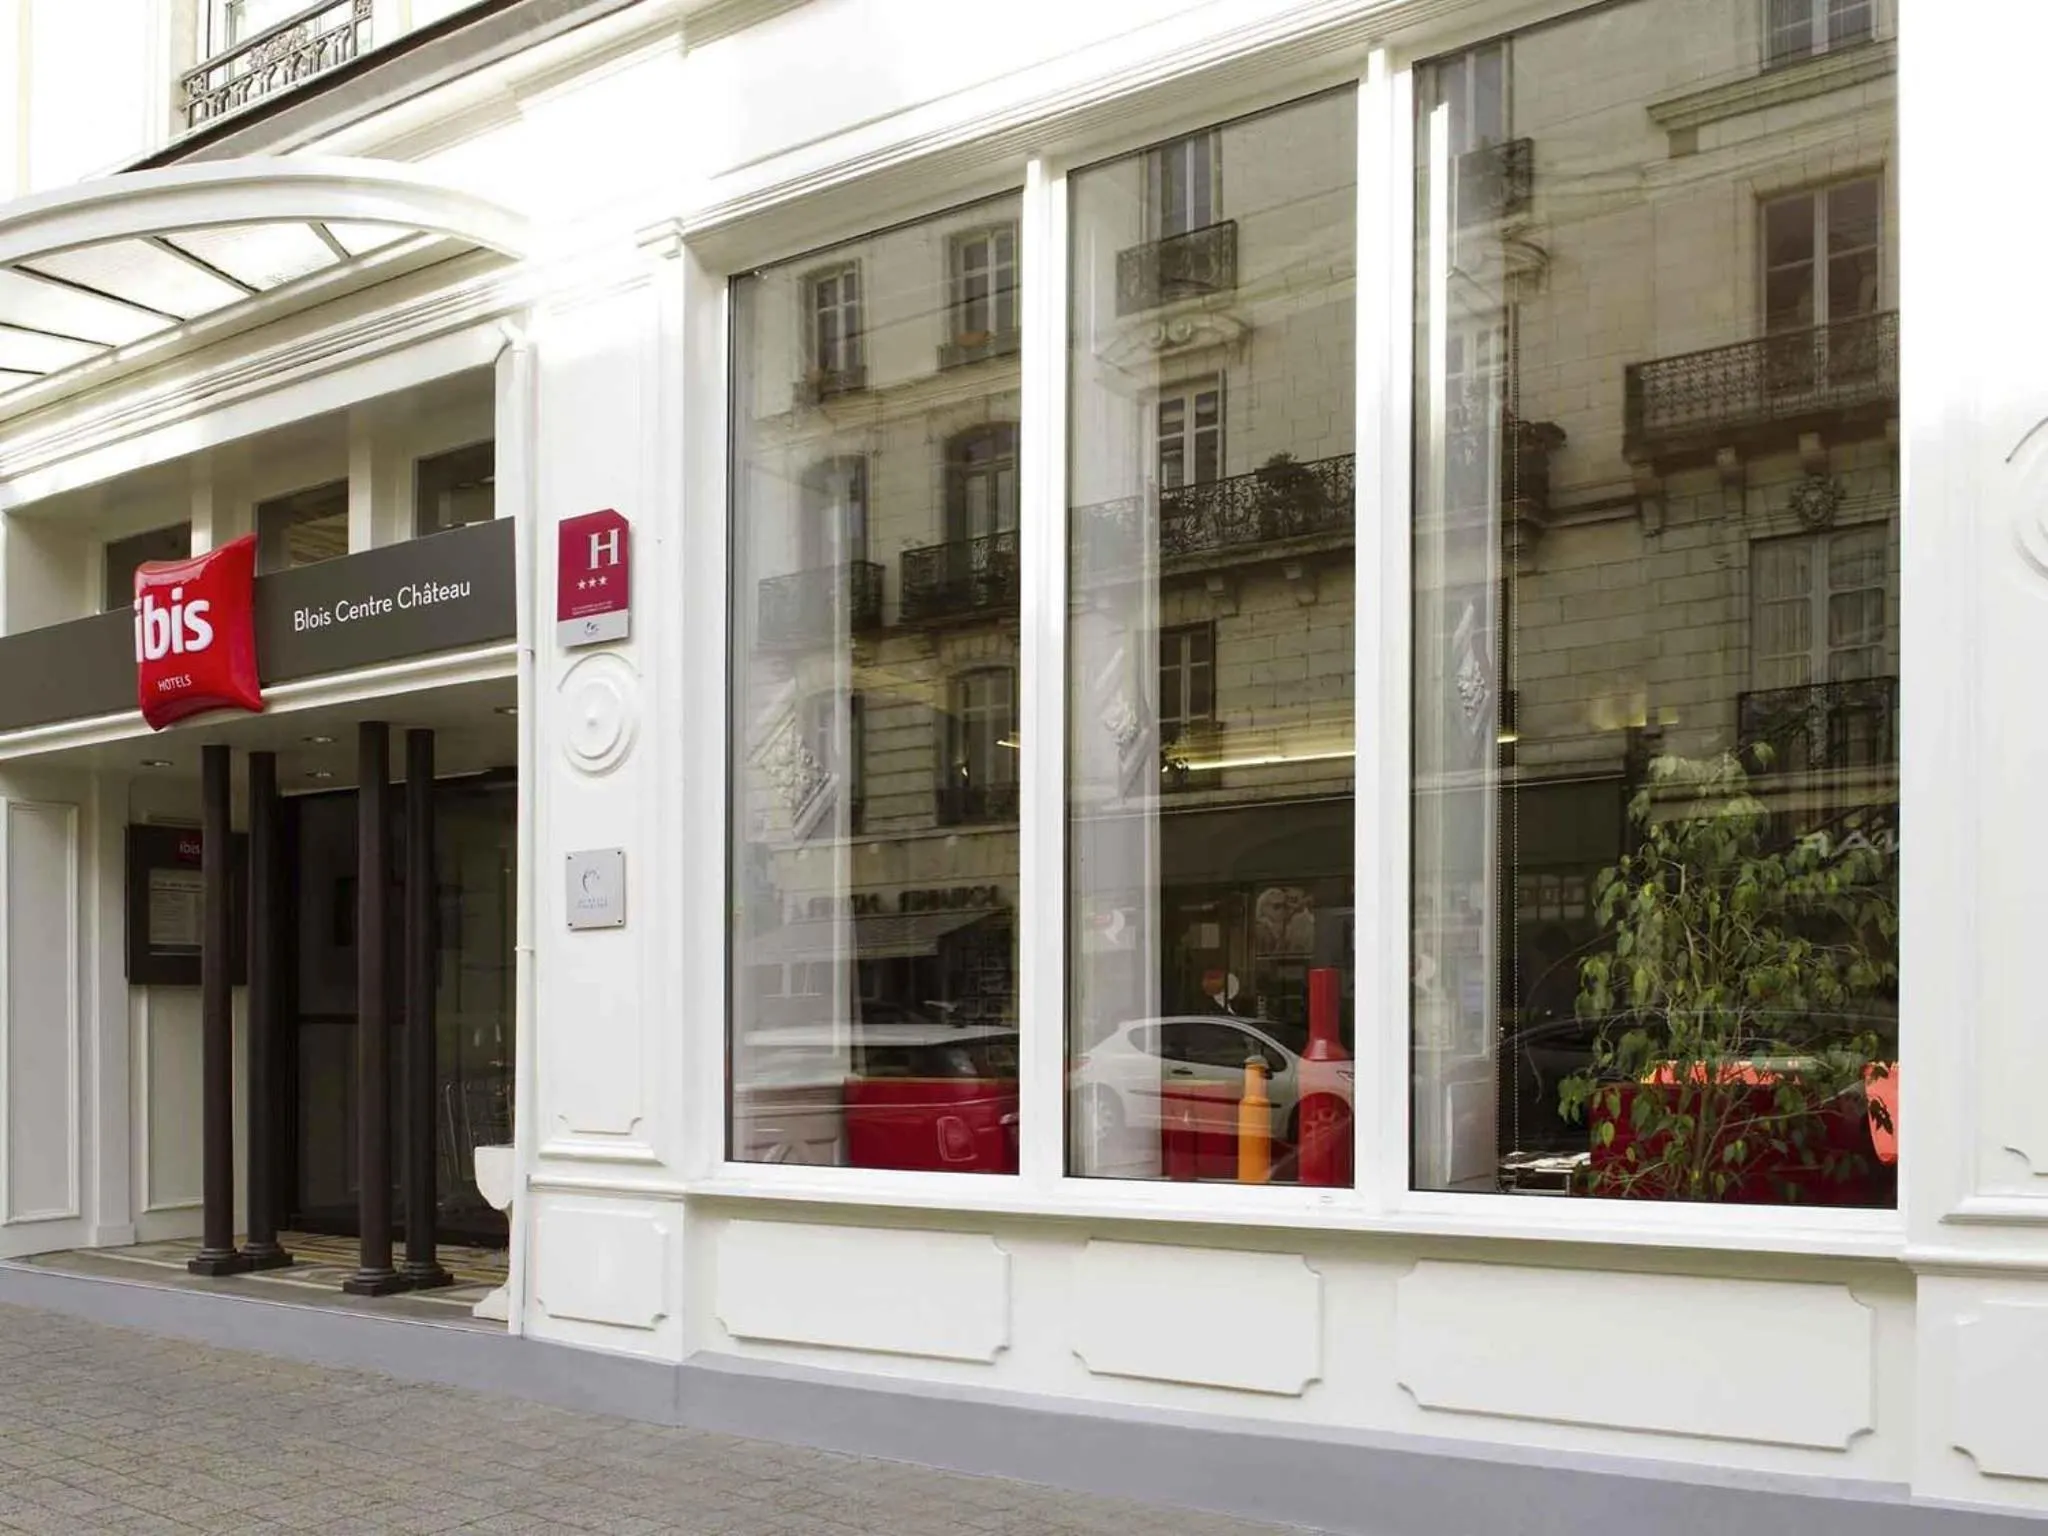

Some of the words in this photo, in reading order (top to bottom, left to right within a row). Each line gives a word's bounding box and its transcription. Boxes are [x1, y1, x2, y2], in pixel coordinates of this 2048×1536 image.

[588, 528, 620, 570] H
[134, 586, 214, 663] ibis
[294, 607, 332, 632] Blois
[335, 596, 393, 622] Centre
[397, 581, 471, 609] Château
[157, 674, 193, 692] HOTELS
